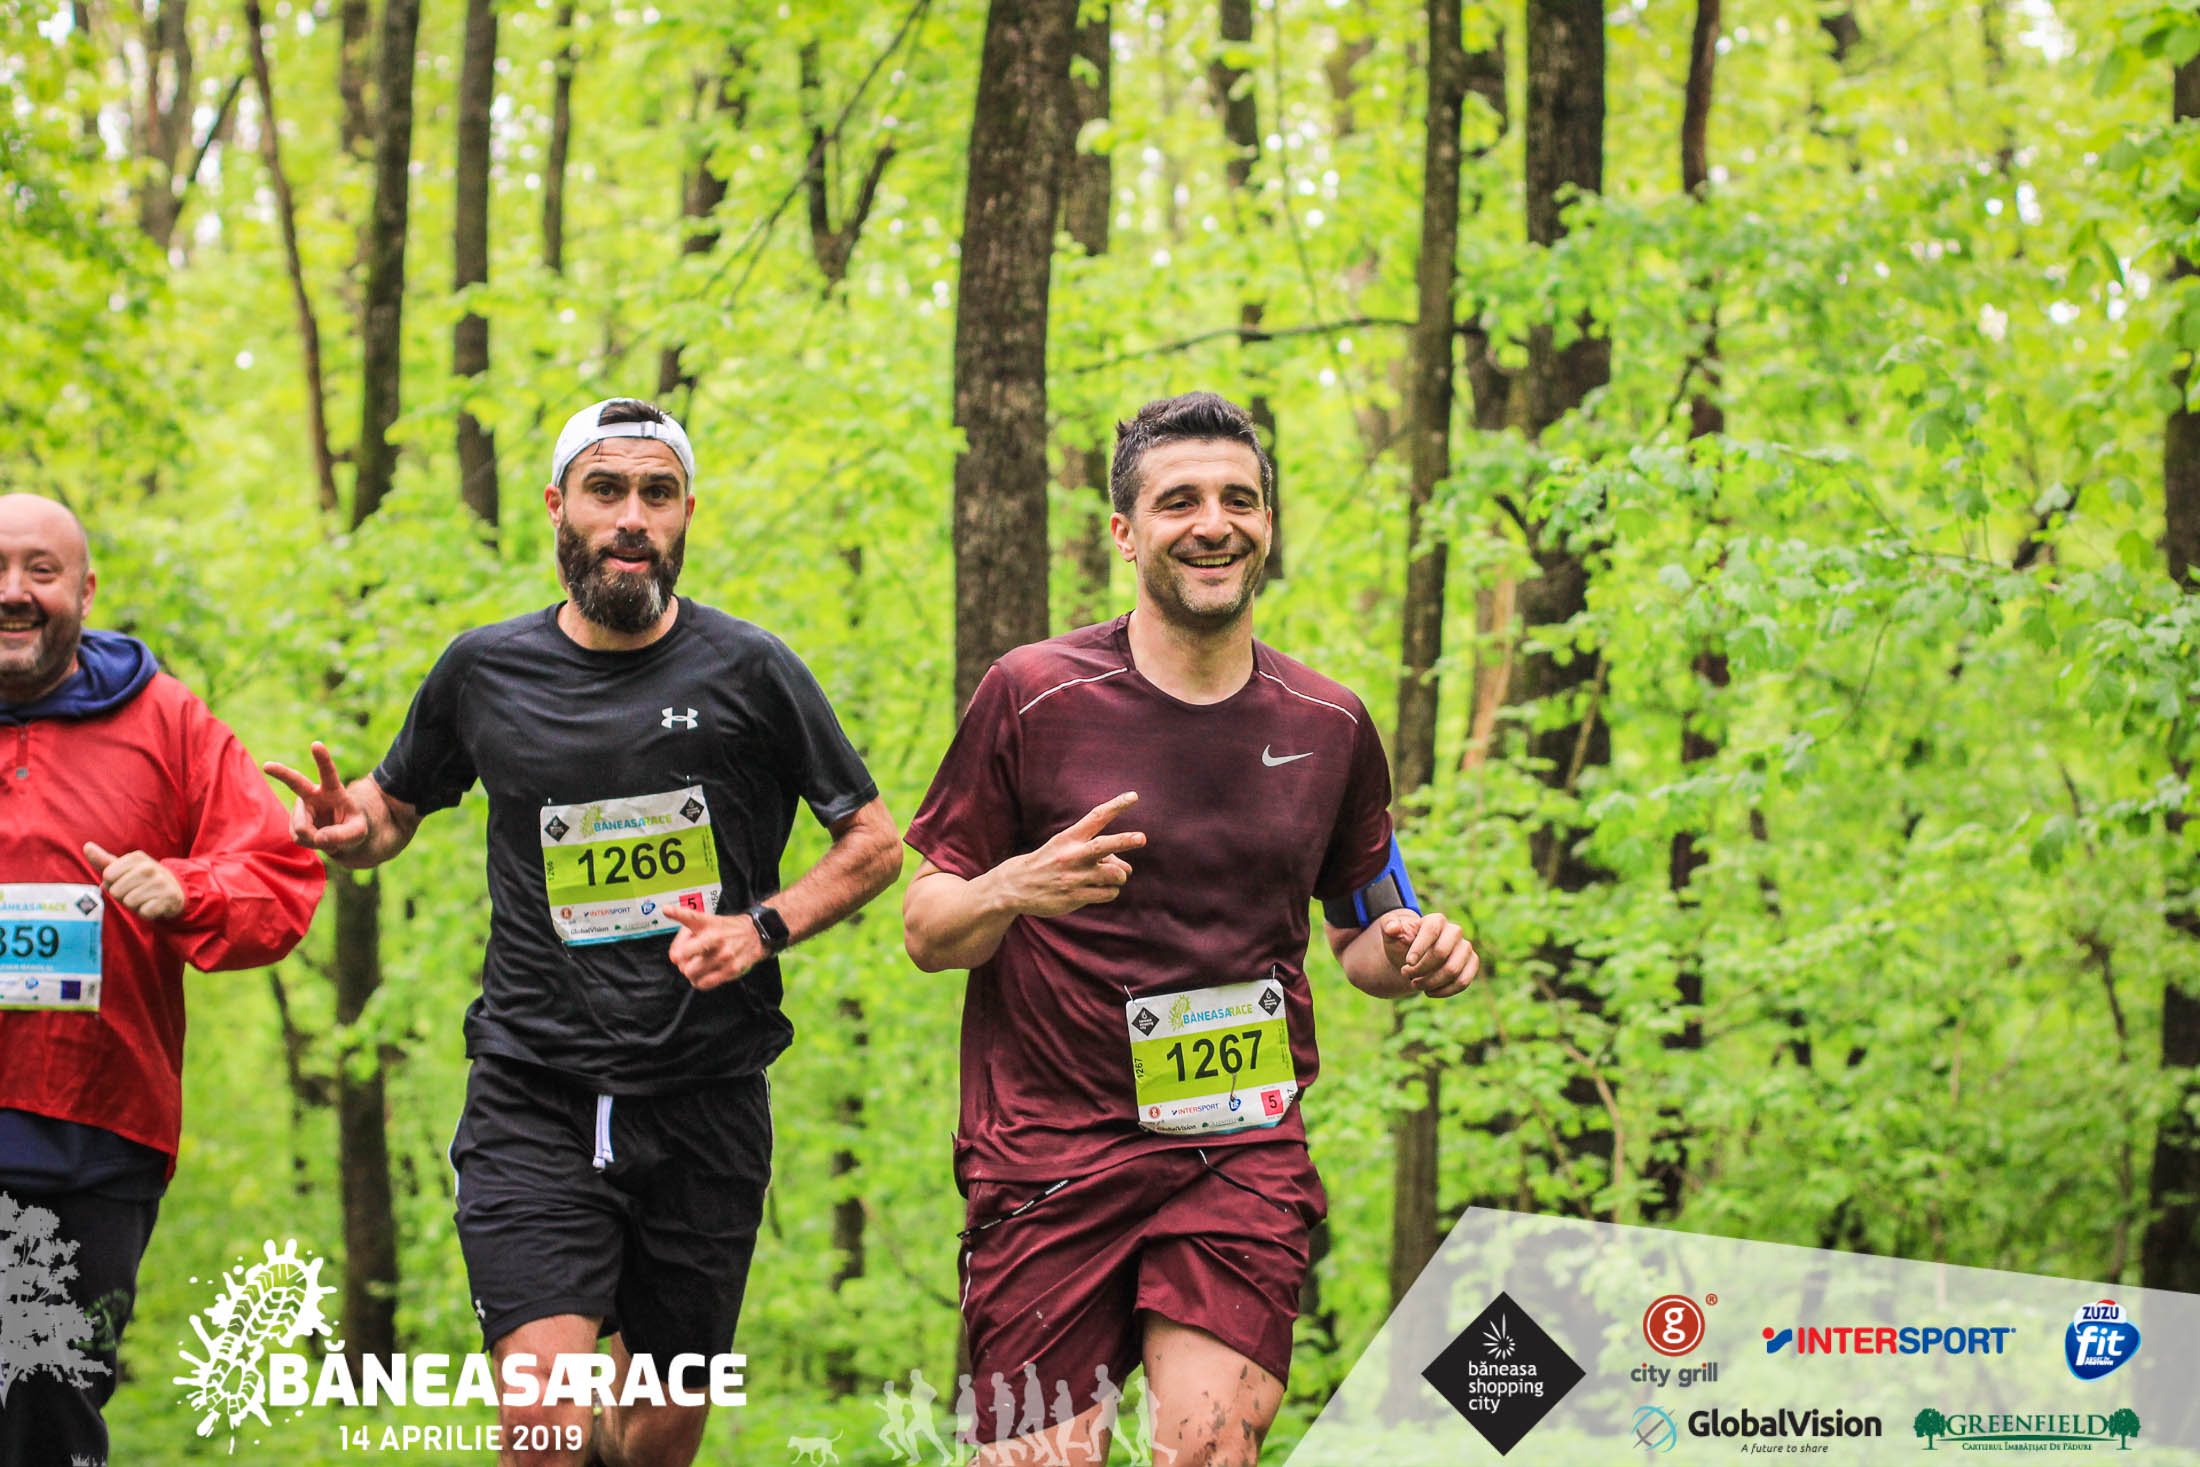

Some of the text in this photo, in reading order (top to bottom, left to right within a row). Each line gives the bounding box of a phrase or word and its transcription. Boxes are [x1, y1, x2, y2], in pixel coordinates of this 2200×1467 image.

[578, 837, 686, 886] 1266
[687, 898, 697, 910] 5
[1166, 1029, 1262, 1082] 1267
[1135, 1057, 1144, 1079] 1267
[1178, 1103, 1220, 1116] INTERSPORT
[1268, 1095, 1278, 1109] 5
